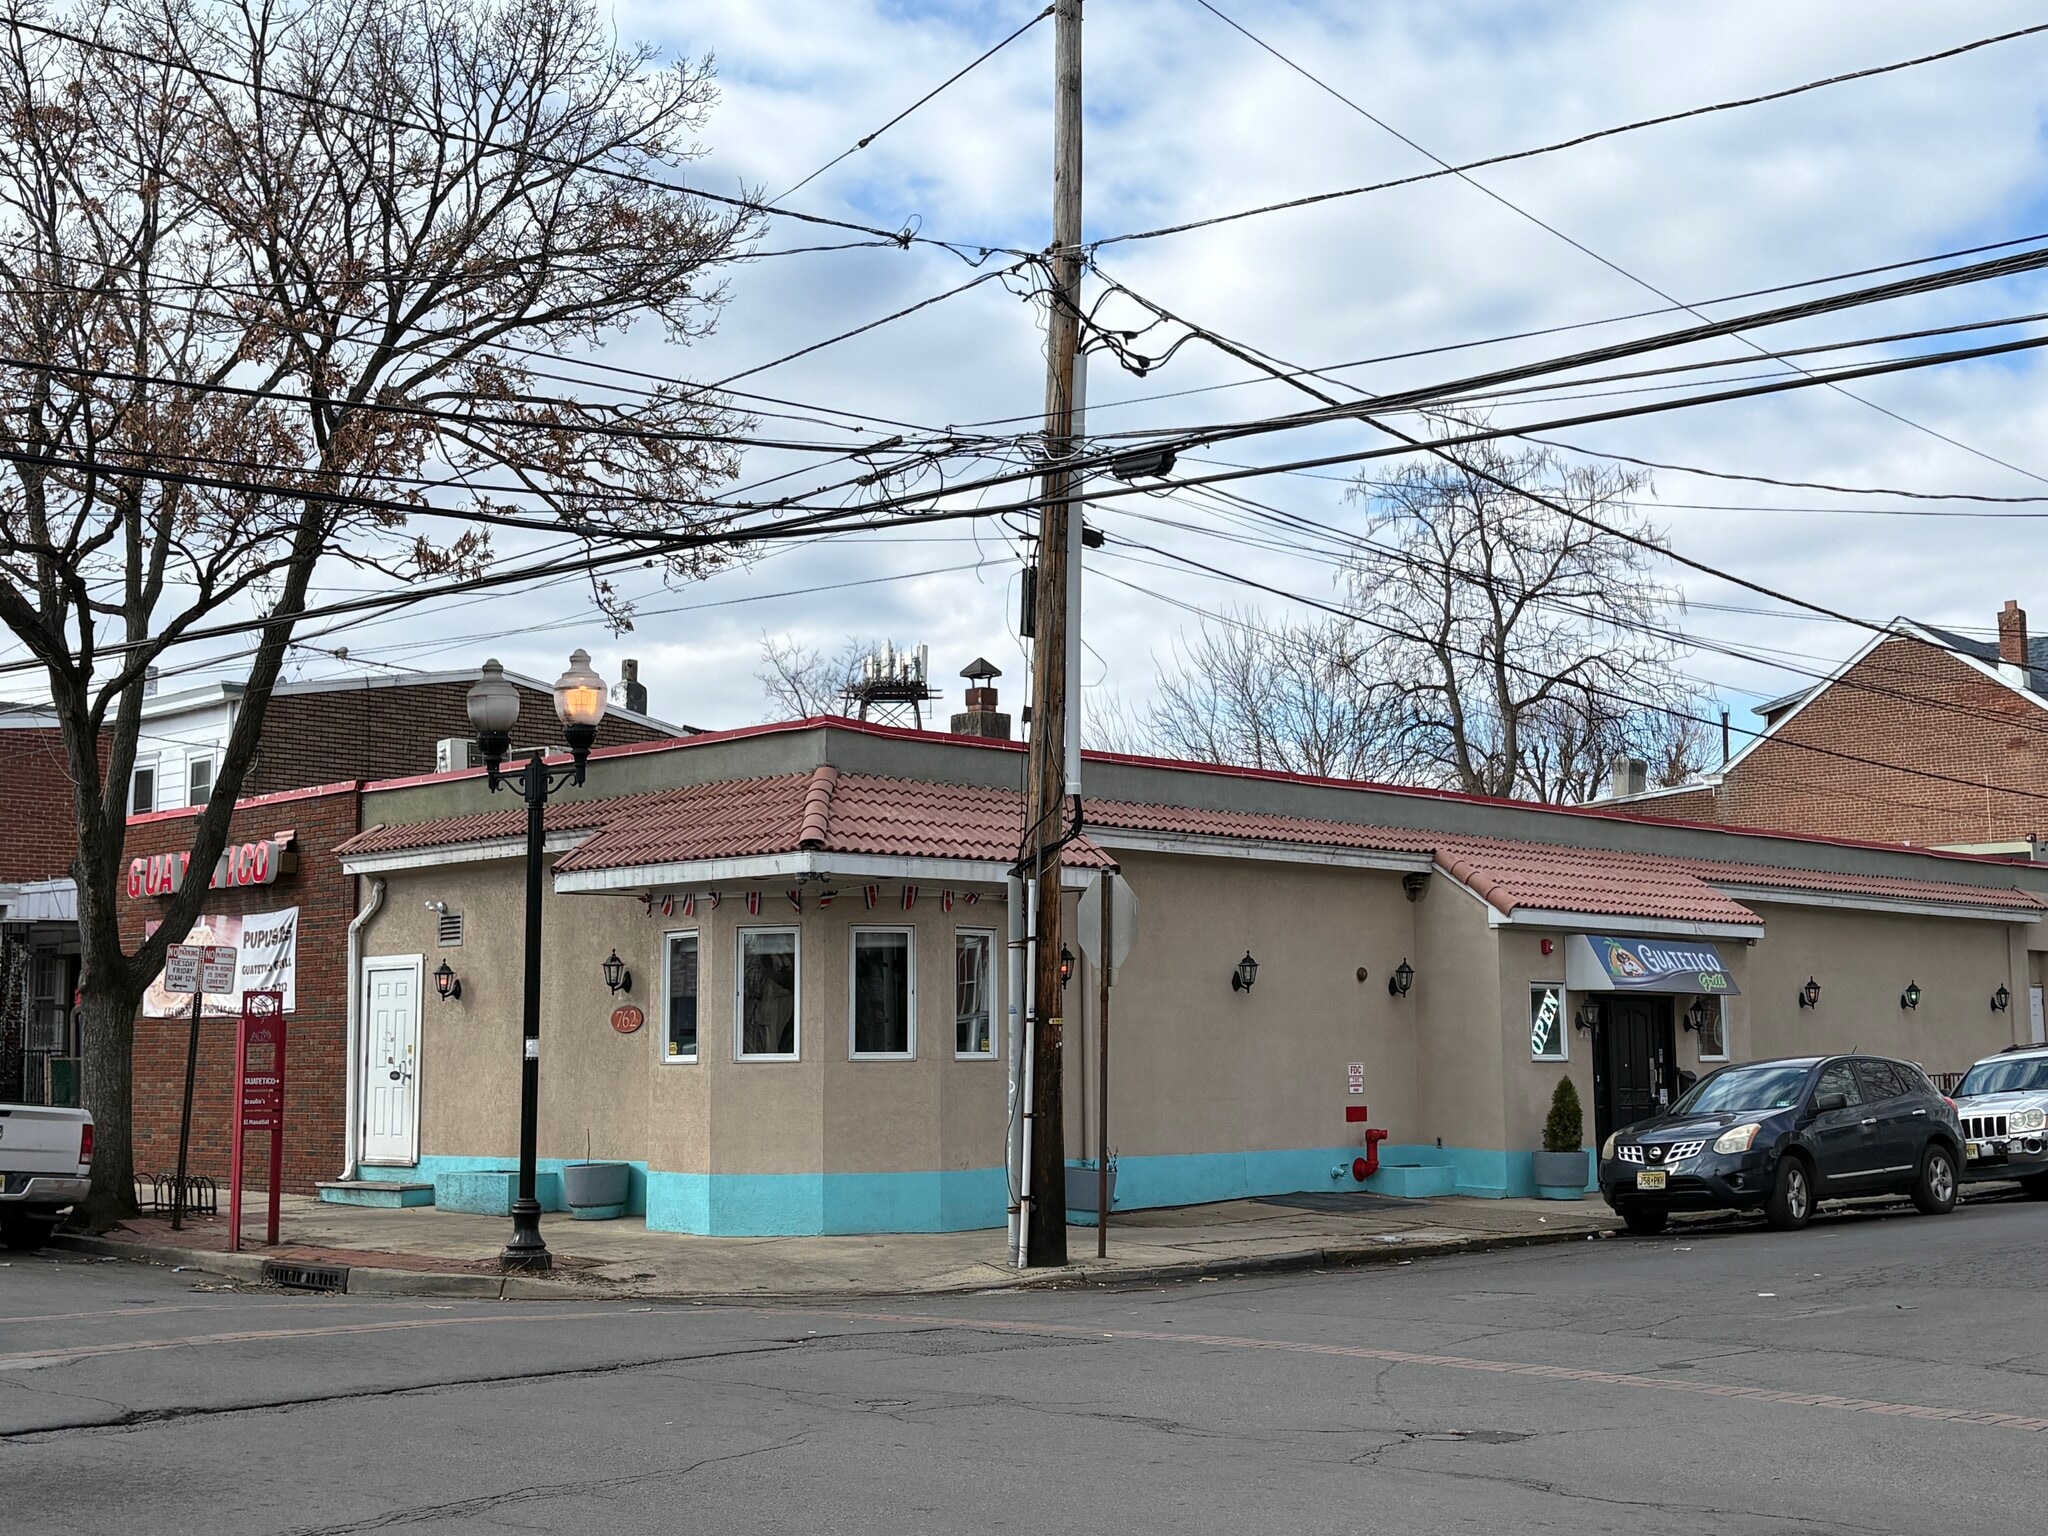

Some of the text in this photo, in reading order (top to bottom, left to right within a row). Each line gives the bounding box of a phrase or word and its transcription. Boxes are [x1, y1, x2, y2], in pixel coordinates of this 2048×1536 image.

[127, 839, 270, 899] GUATICO
[169, 947, 199, 957] NO PARKING
[205, 950, 215, 960] NO
[173, 967, 194, 975] FRIDAY
[616, 1010, 637, 1028] 762
[1531, 989, 1559, 1055] OPEN
[1350, 1065, 1362, 1075] FDC
